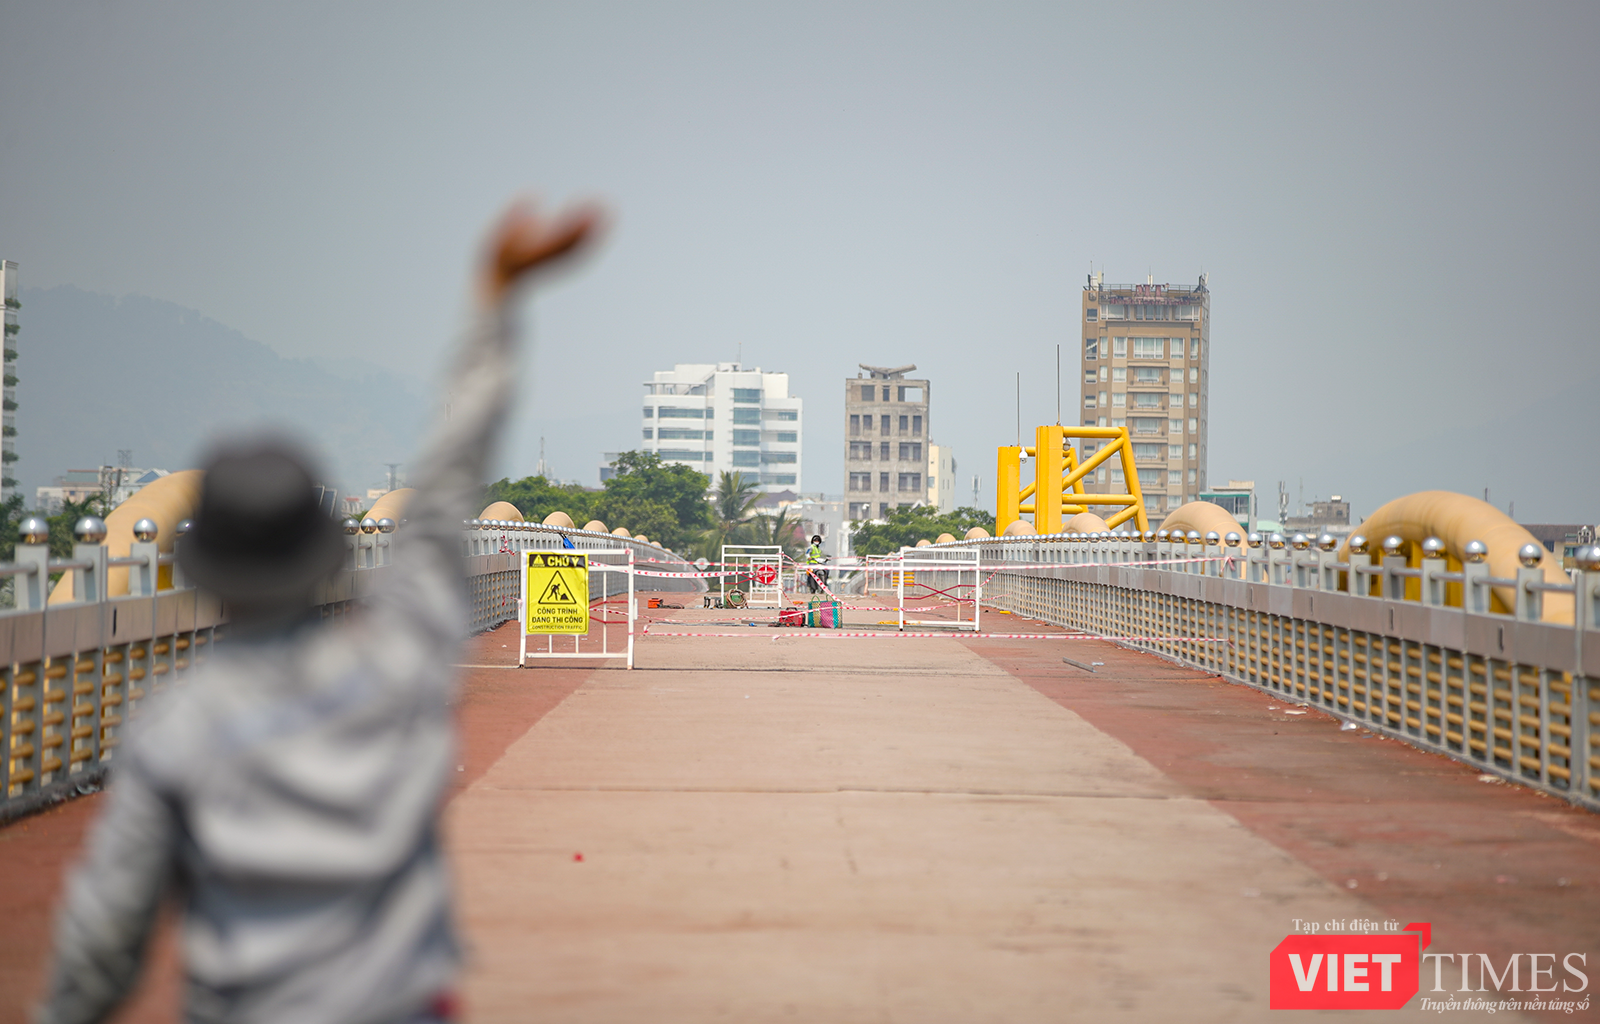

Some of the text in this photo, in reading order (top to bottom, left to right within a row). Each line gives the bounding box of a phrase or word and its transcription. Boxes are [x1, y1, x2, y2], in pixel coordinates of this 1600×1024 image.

[537, 607, 578, 615] CÔNG TRÌNH
[564, 615, 583, 623] CÔNG
